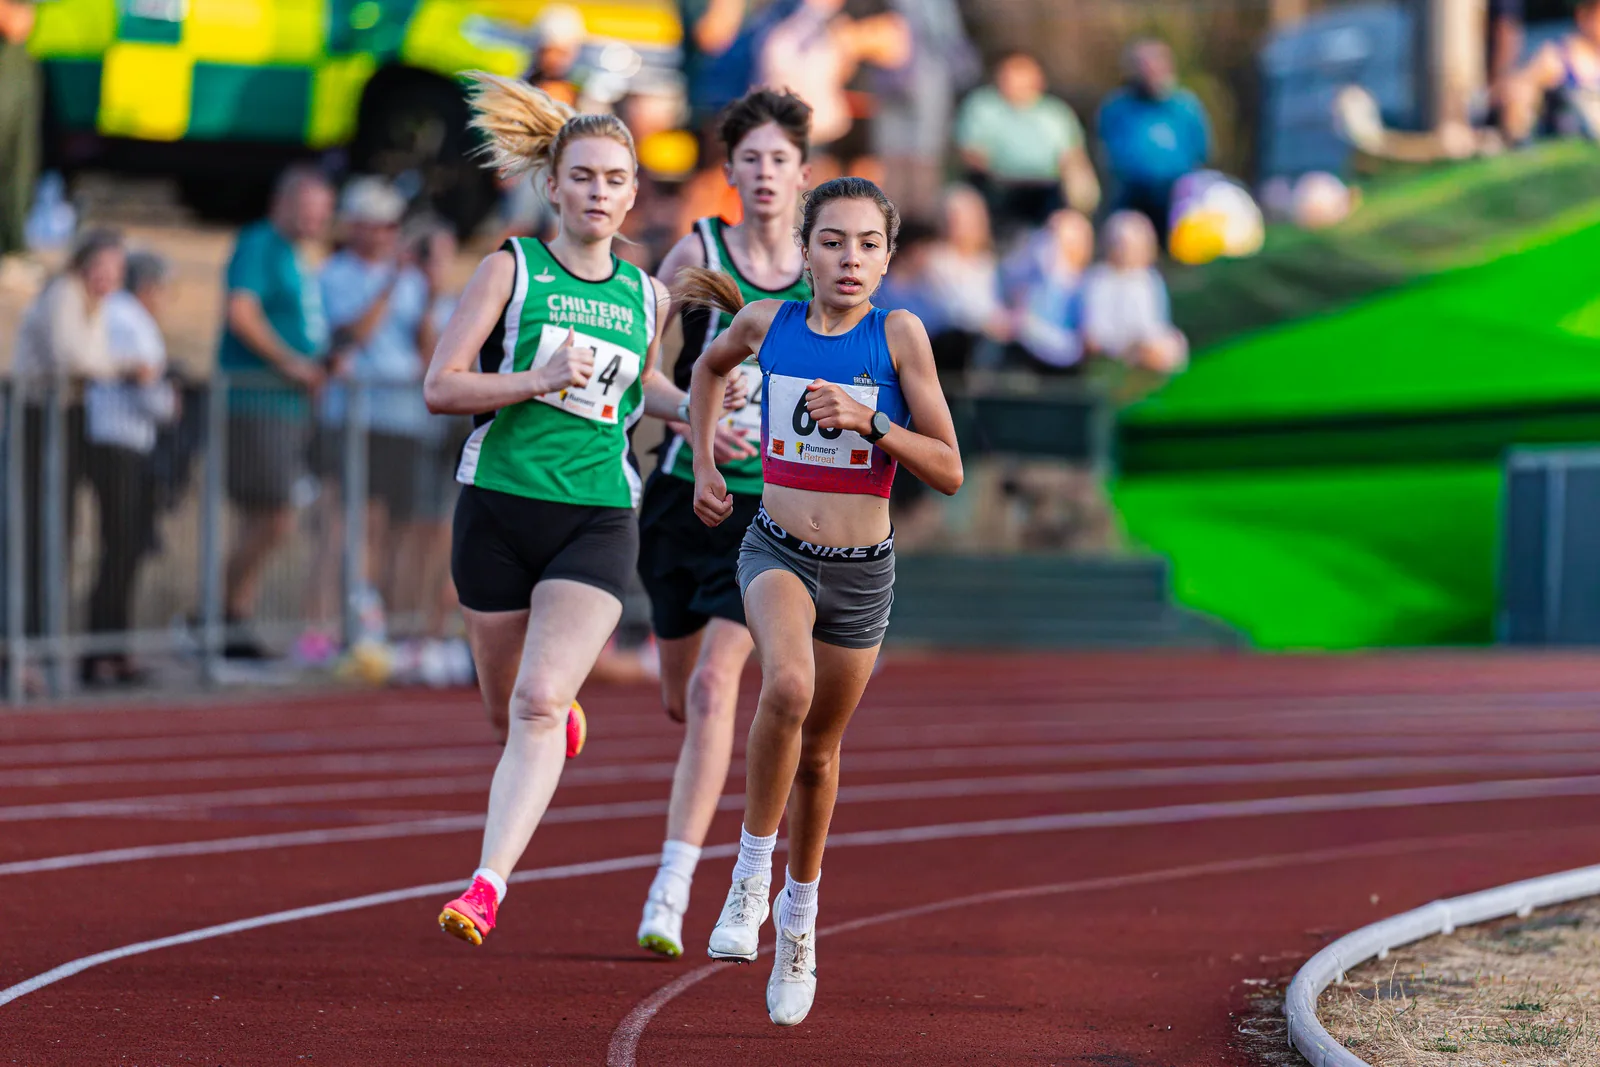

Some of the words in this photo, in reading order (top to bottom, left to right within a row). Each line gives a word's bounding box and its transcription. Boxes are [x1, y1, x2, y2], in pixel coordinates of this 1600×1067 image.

[547, 294, 633, 325] CHILTERN
[549, 311, 613, 330] HARRIERS
[589, 345, 622, 396] 4
[803, 452, 835, 464] Retreat
[757, 500, 787, 539] RO
[798, 540, 871, 558] NIKE
